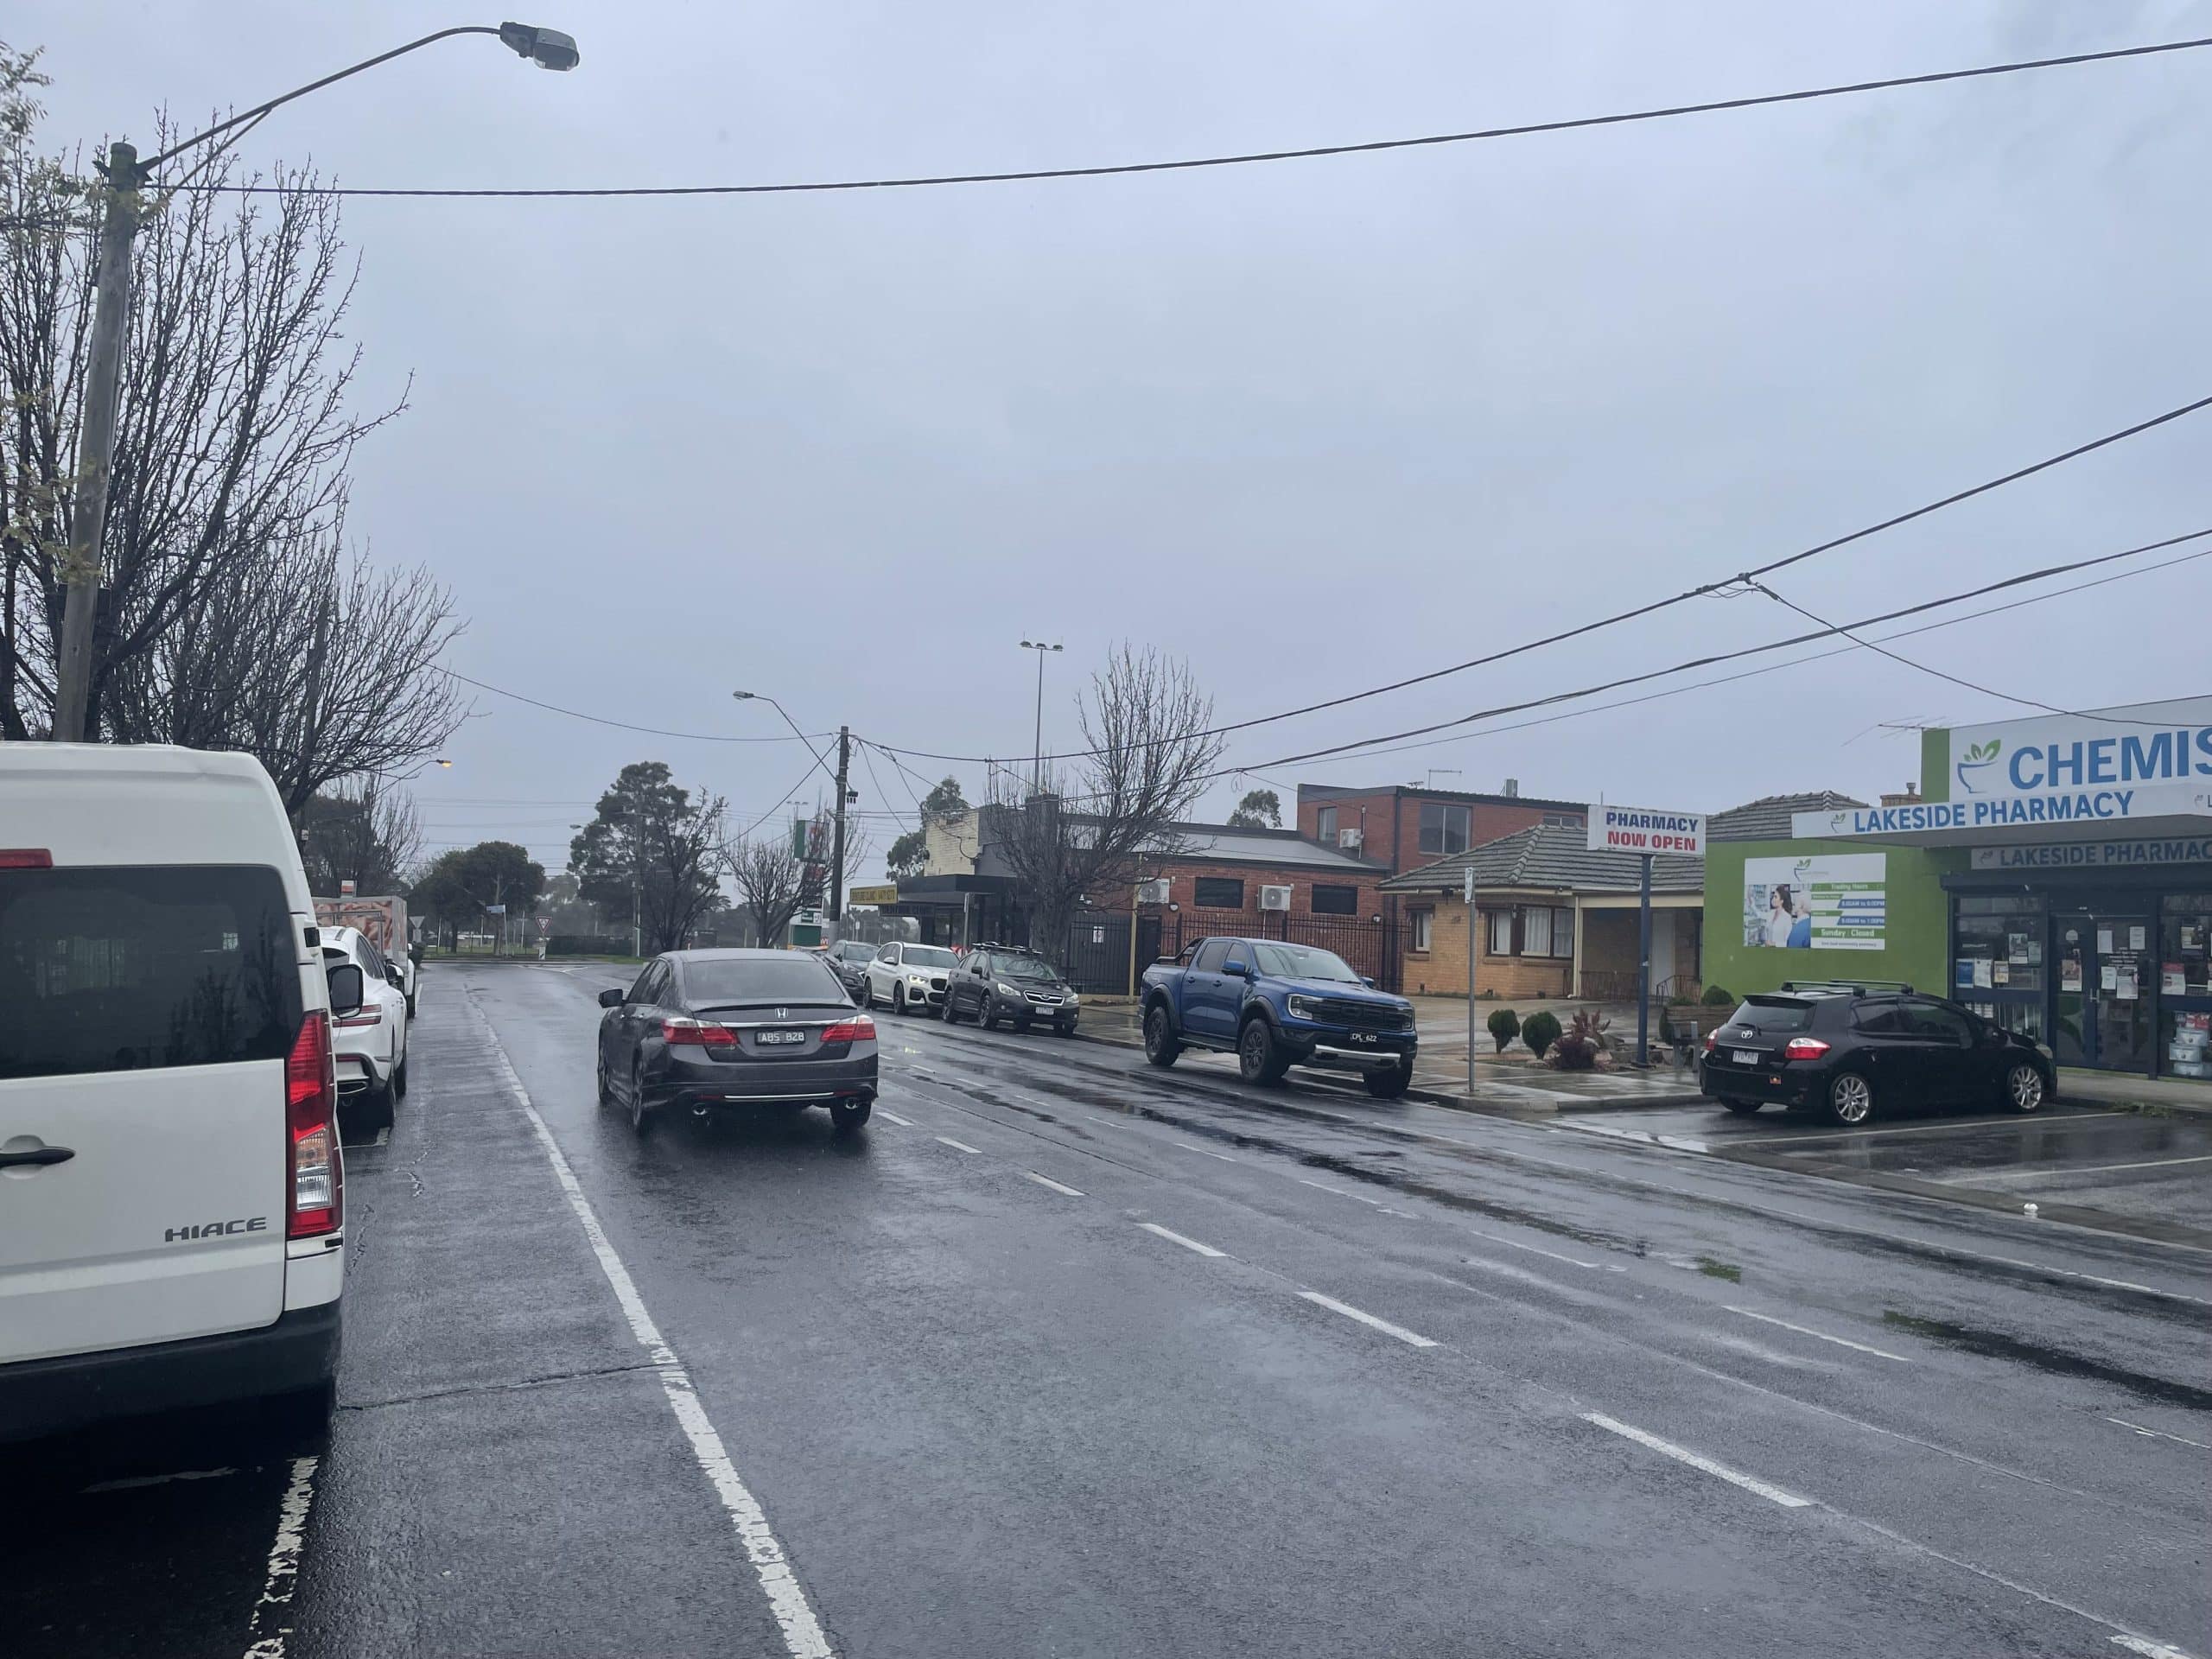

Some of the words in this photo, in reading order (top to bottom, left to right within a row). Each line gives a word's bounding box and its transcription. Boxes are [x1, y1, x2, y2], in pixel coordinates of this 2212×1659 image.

[1605, 811, 1699, 833] PHARMACY
[1854, 804, 1966, 833] LAKESIDE
[1974, 791, 2134, 824] PHARMACY
[1607, 831, 1647, 847] NOW
[1651, 835, 1697, 851] OPEN
[1999, 845, 2096, 867] LAKESIDE
[1821, 928, 1846, 938] Sunday
[165, 1216, 267, 1243] HIACE
